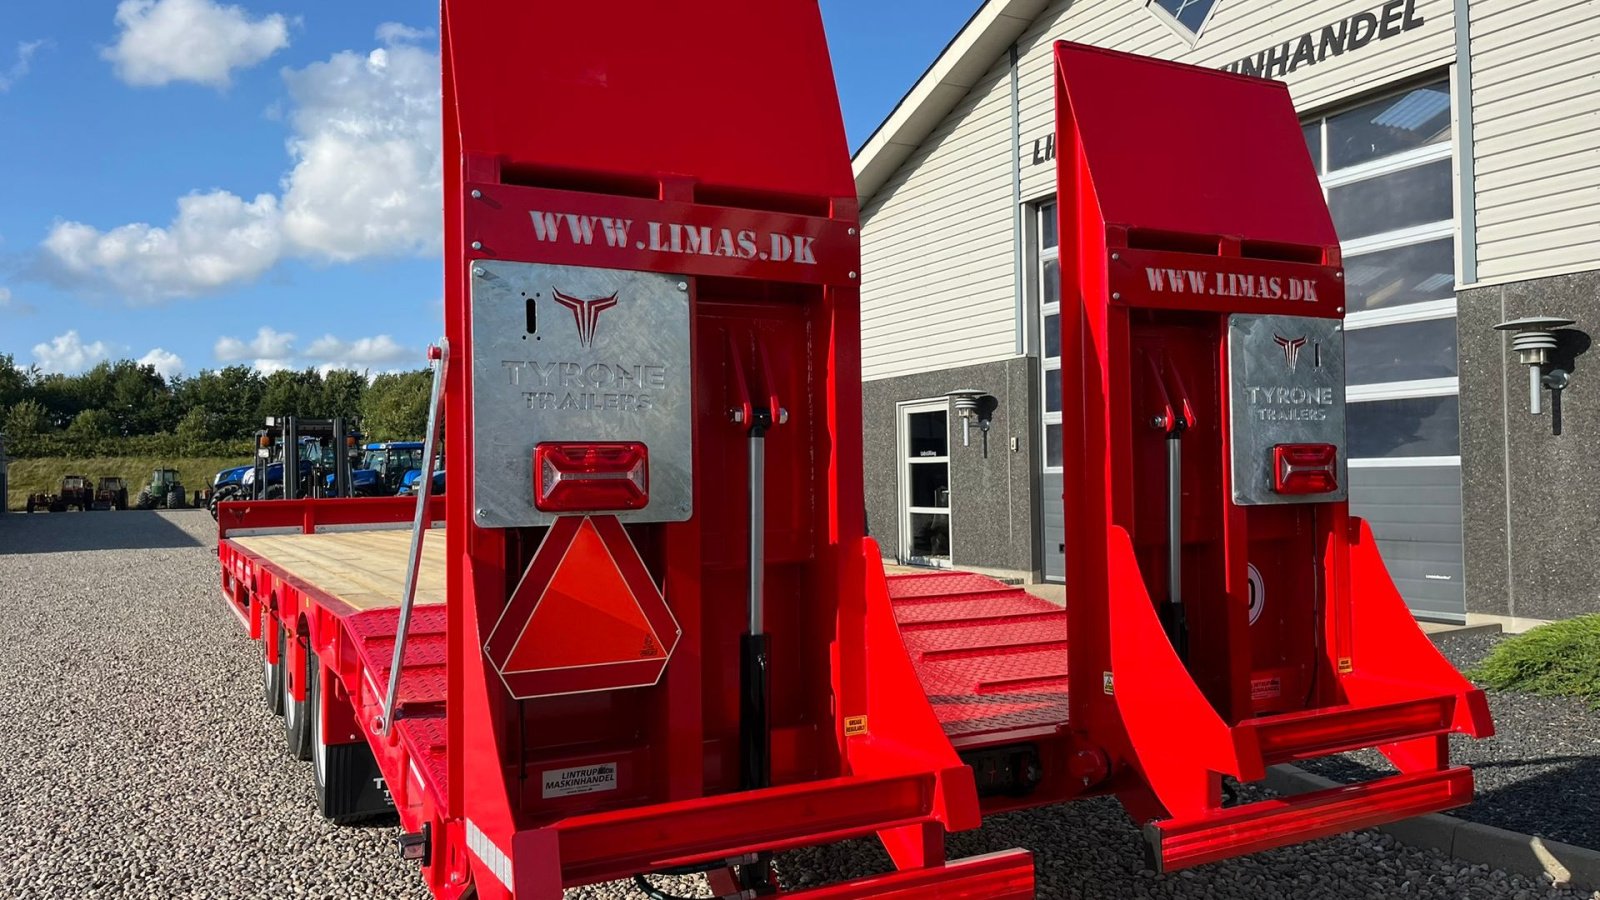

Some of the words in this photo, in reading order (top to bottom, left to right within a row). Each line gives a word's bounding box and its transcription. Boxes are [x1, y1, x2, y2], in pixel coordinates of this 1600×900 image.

[529, 210, 817, 265] WWW.LIMAS.DK
[1145, 267, 1319, 302] WWW.LIMAS.DK
[501, 360, 666, 390] TYRONE
[521, 391, 653, 412] TRAILERS
[1247, 384, 1333, 405] TYRONE
[1258, 408, 1326, 421] TRAILERS
[546, 774, 615, 790] MASKINHANDEL
[562, 768, 598, 780] LINTRUP
